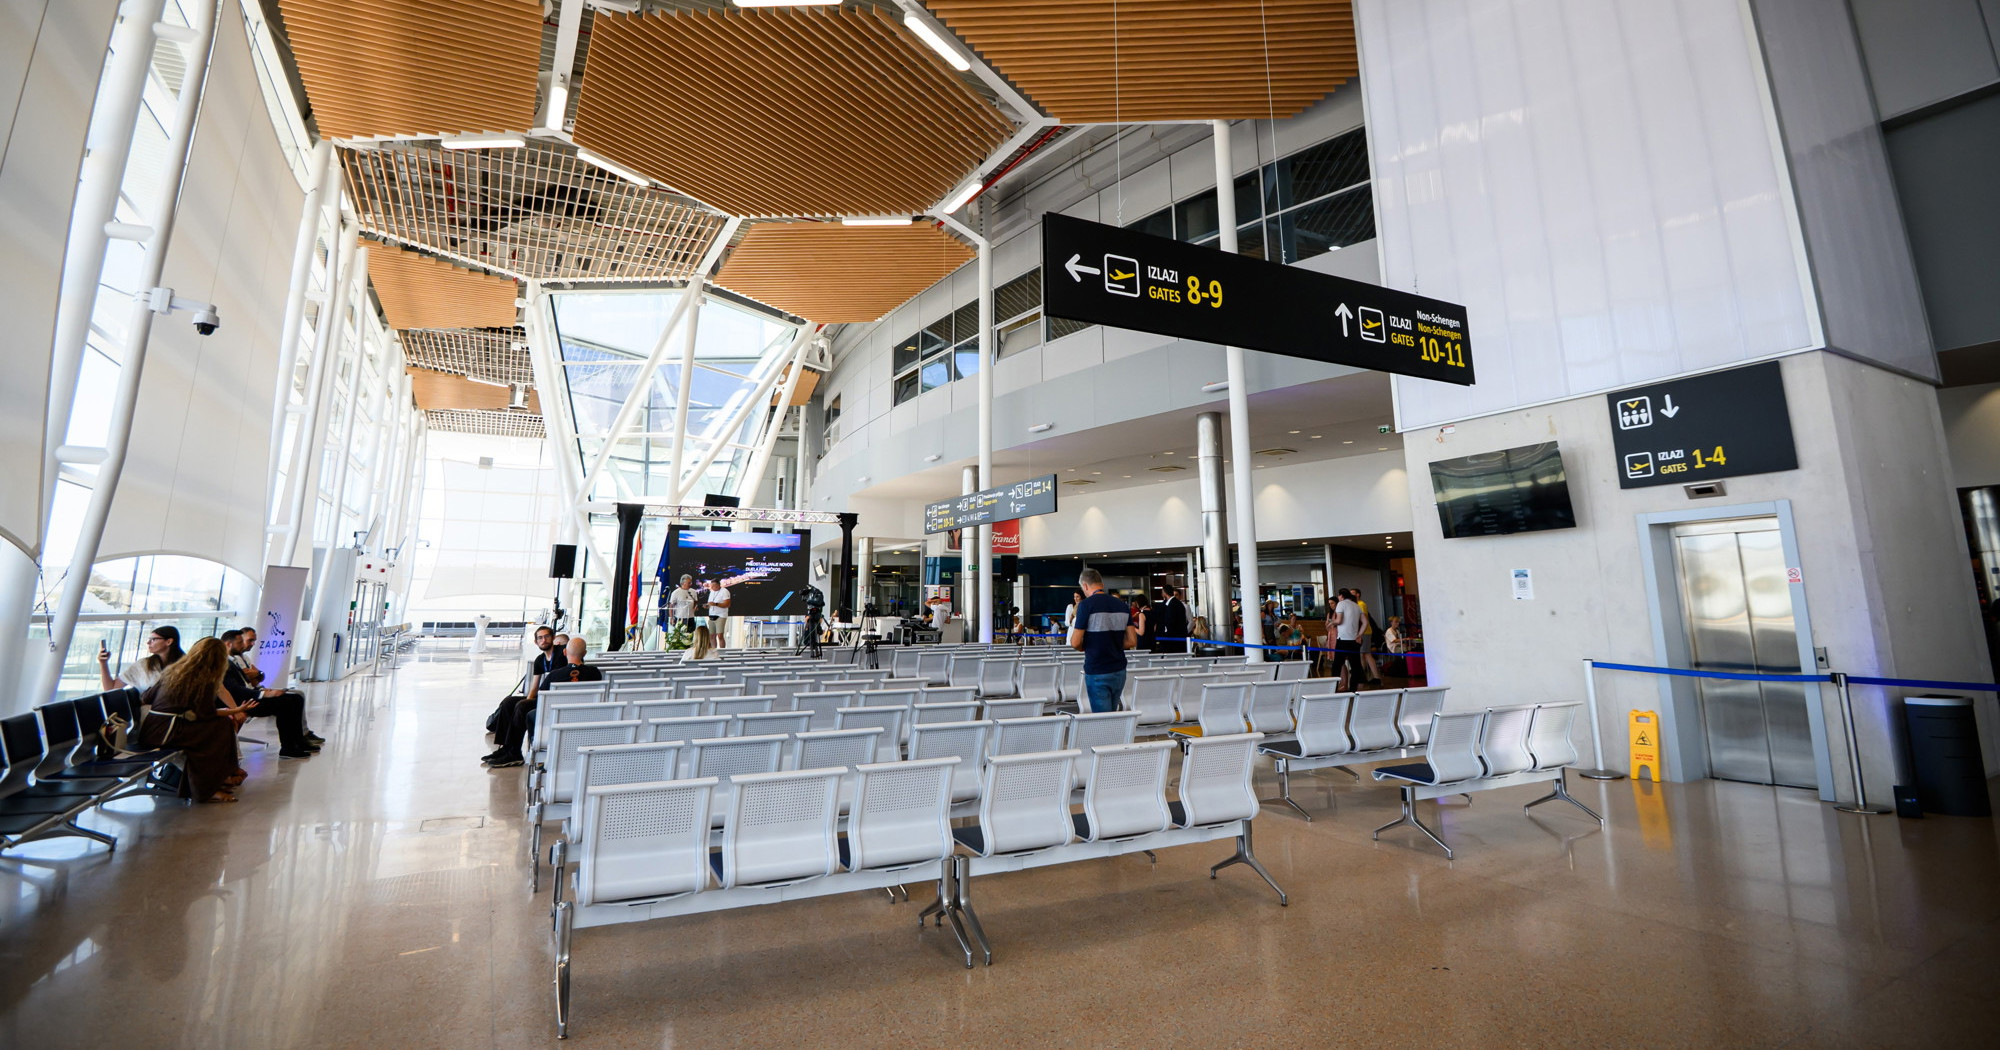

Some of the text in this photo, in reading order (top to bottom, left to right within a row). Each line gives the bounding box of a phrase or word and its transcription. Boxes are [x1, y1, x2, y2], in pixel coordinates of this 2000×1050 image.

[1147, 265, 1178, 284] IZLAZI
[1148, 275, 1223, 308] GATES 8-9
[1389, 315, 1412, 331] IZLAZI
[1416, 309, 1461, 328] Non-Schengen
[1417, 322, 1462, 340] Non-Schengen
[1390, 332, 1465, 368] GATES 10-11
[1657, 449, 1684, 461] IZLAZI
[1660, 445, 1726, 475] GATES 1-4
[1042, 480, 1052, 493] 1-4
[943, 517, 954, 528] 10-11
[259, 640, 292, 649] ZADAR
